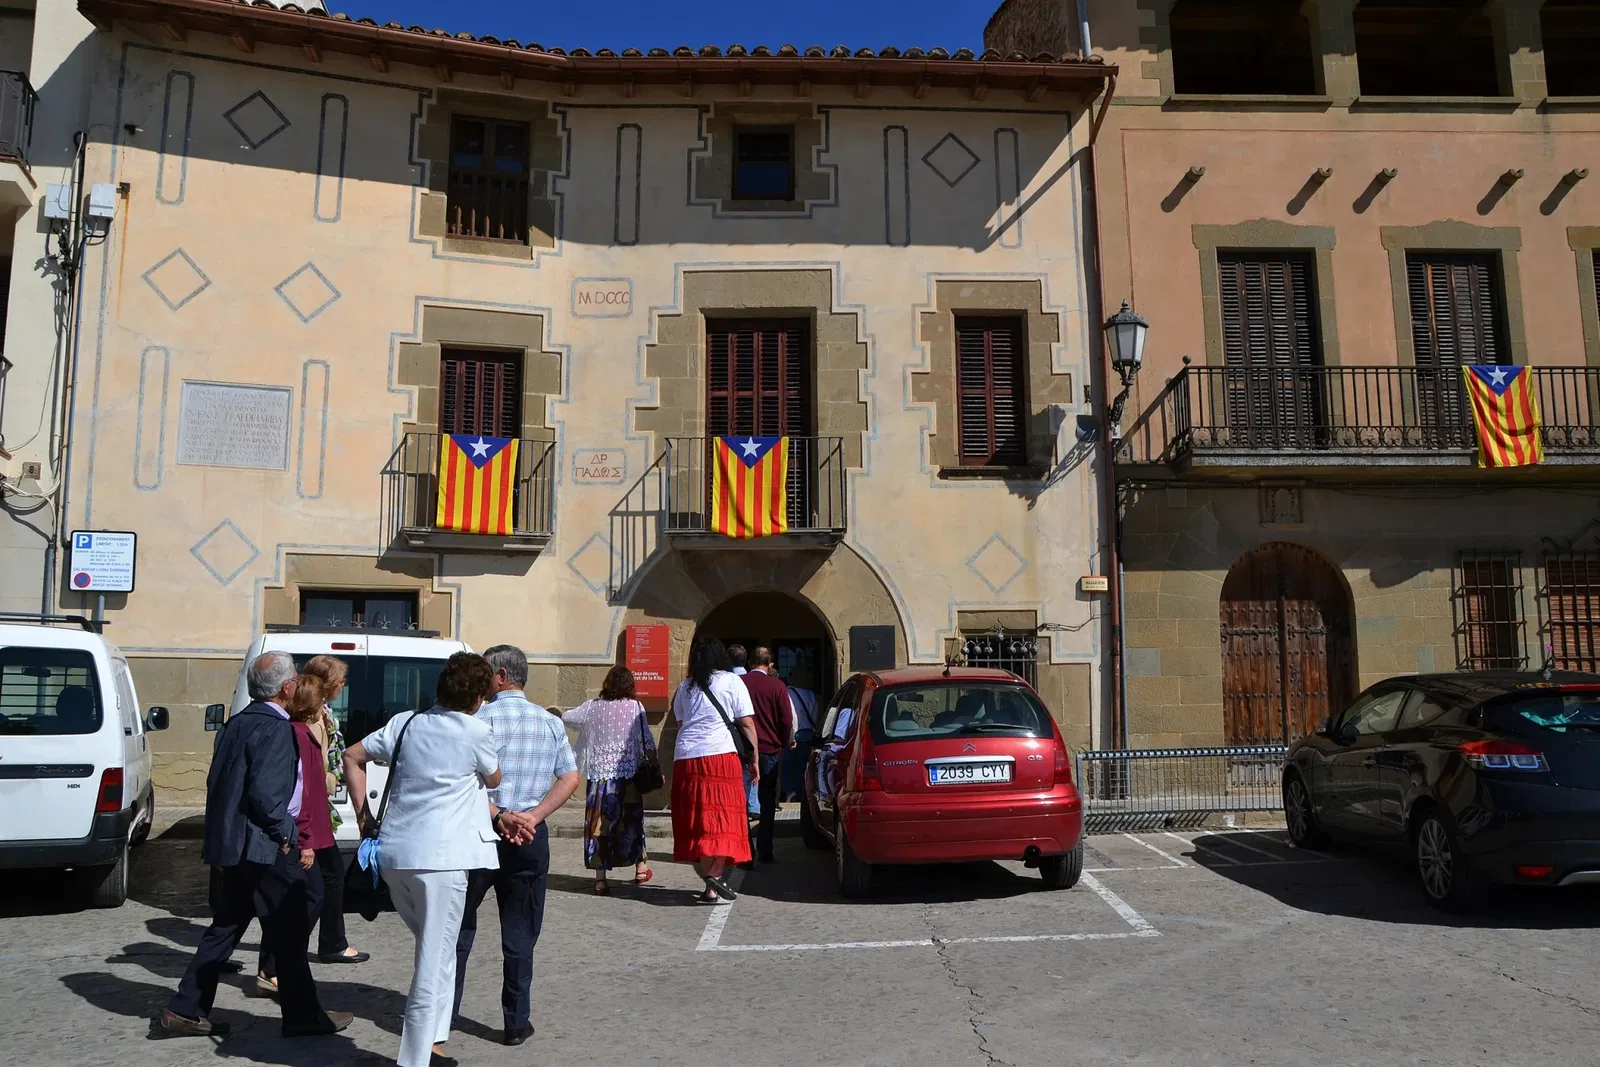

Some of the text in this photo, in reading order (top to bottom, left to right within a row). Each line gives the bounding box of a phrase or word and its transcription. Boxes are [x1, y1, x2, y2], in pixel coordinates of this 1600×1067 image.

[79, 535, 90, 547] P
[940, 765, 974, 780] 2039
[981, 764, 1007, 778] CYY
